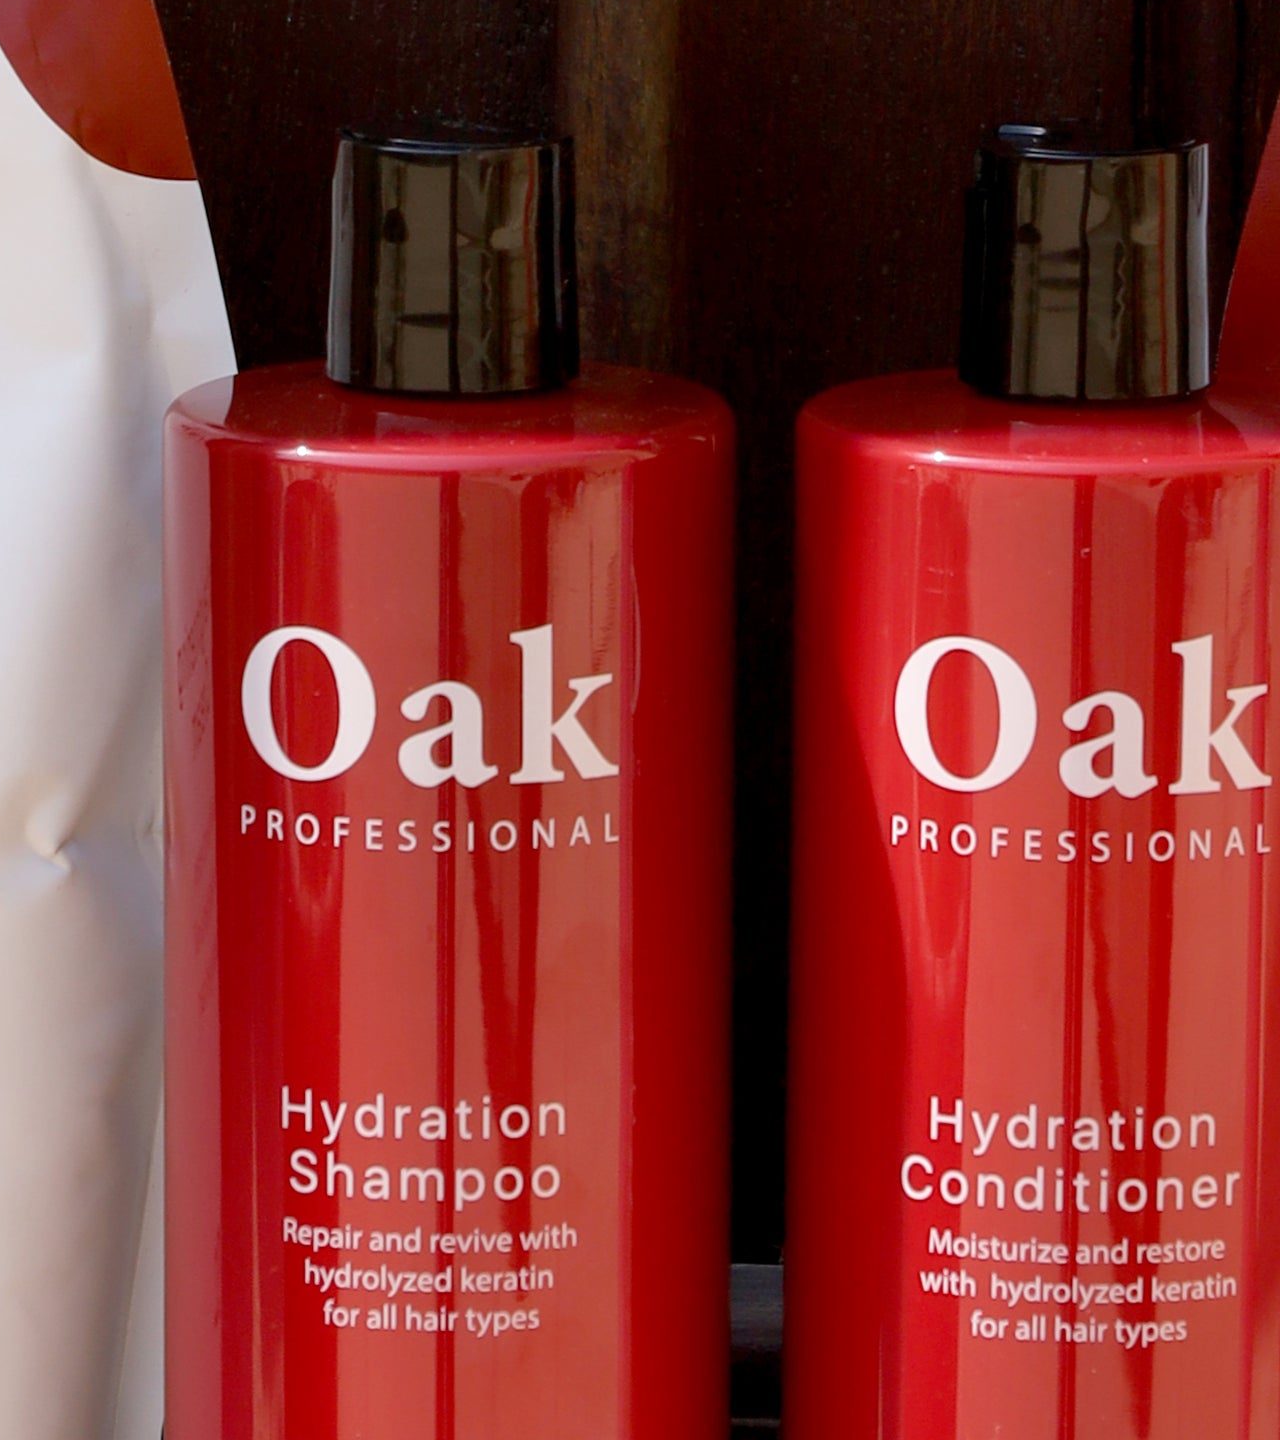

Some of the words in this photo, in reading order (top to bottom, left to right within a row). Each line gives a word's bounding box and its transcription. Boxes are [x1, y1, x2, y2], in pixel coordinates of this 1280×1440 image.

[241, 624, 619, 789] Oak
[894, 634, 1272, 799] Oak
[240, 804, 619, 853] PROFESSIONAL
[890, 814, 1271, 863] PROFESSIONAL
[280, 1085, 567, 1145] Hydration
[929, 1096, 1217, 1155] Hydration
[288, 1149, 561, 1211] Shampoo
[900, 1154, 1241, 1214] Conditioner
[283, 1216, 362, 1253] Repair
[369, 1225, 421, 1254] and
[429, 1226, 513, 1254] revive
[519, 1222, 577, 1250] with
[928, 1227, 1069, 1264] Moisturize
[1075, 1237, 1128, 1264] and
[1136, 1237, 1225, 1263] restore
[303, 1258, 452, 1294] hydrolyzed
[460, 1266, 554, 1293] keratin
[920, 1269, 976, 1298] with
[990, 1273, 1144, 1310] hydrolyzed
[1151, 1273, 1236, 1303] keratin
[322, 1298, 359, 1328] for
[366, 1302, 397, 1331] all
[405, 1302, 456, 1332] hair
[465, 1302, 540, 1337] types
[970, 1310, 1008, 1339] for
[1014, 1313, 1047, 1342] all
[1054, 1314, 1106, 1343] hair
[1113, 1317, 1188, 1349] types
